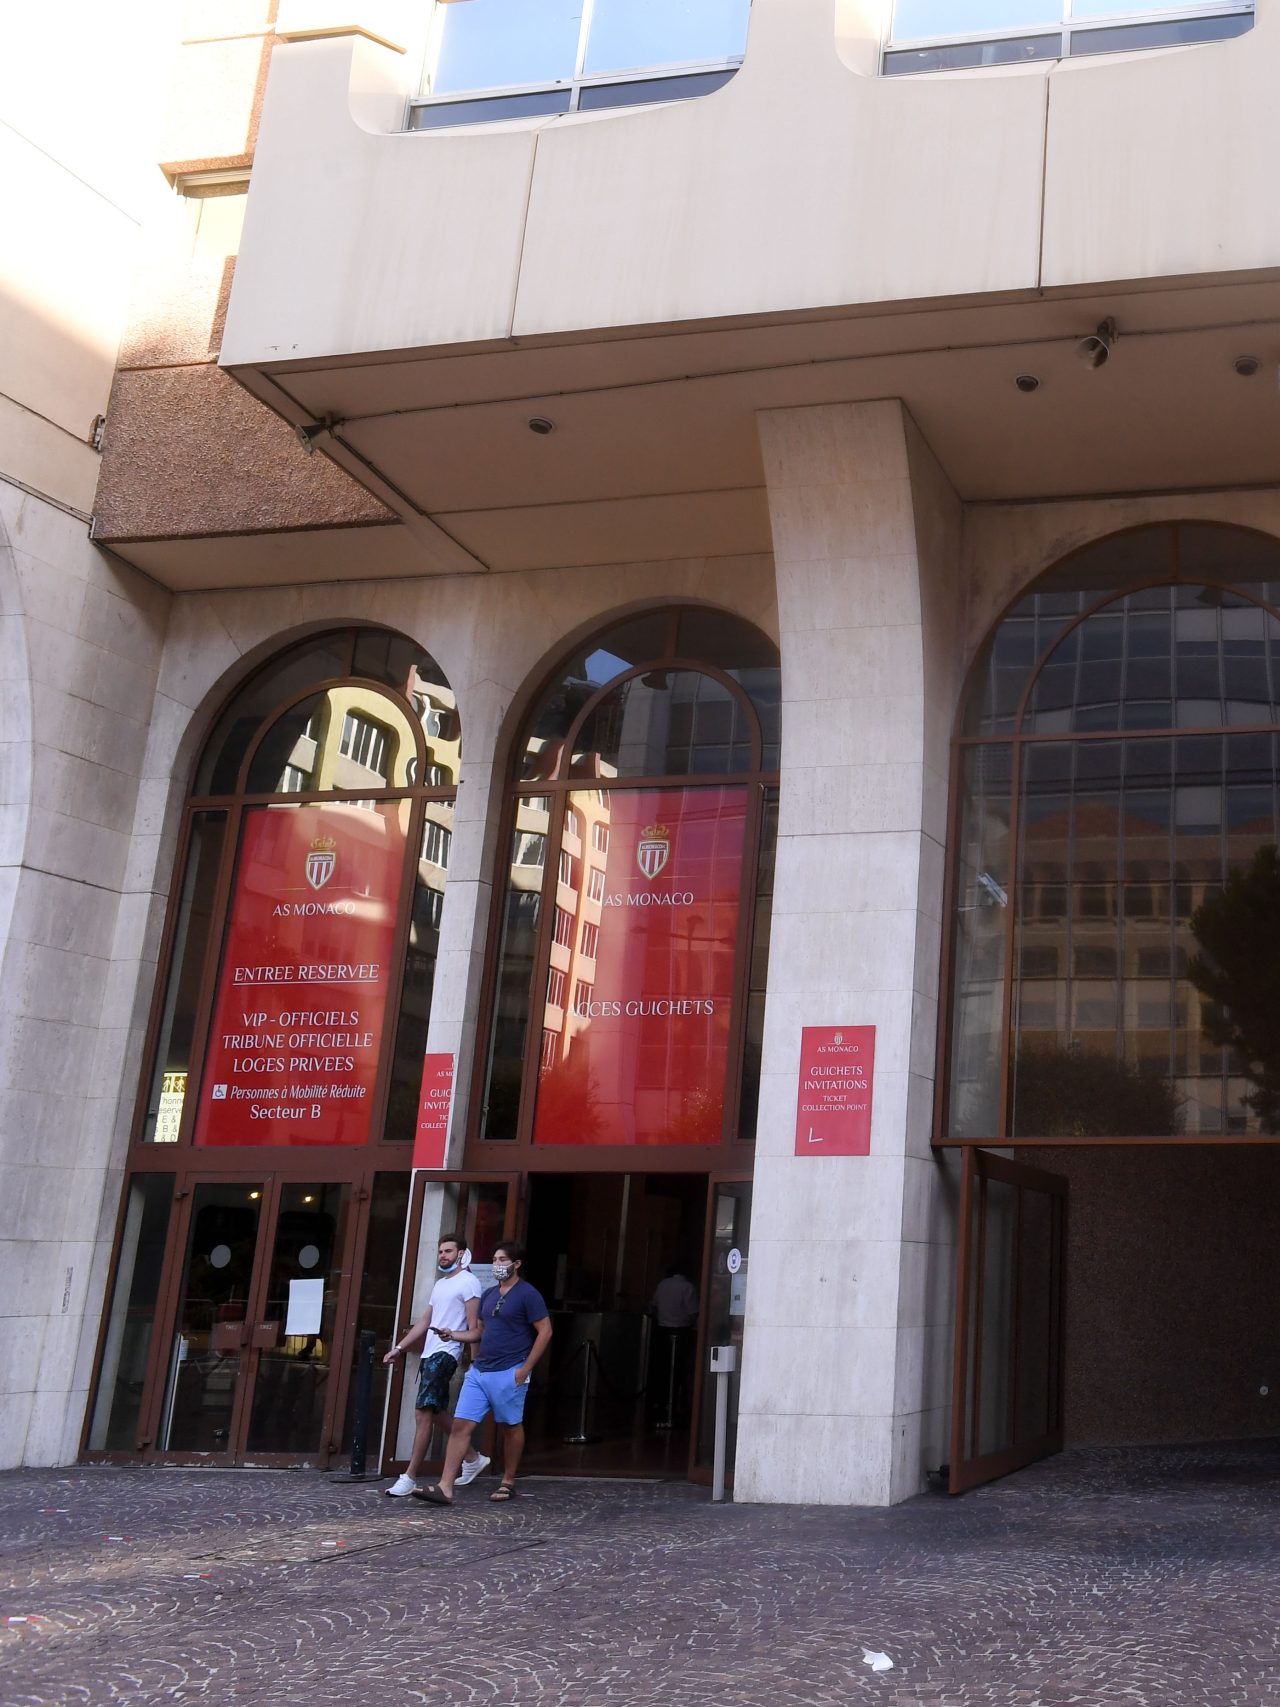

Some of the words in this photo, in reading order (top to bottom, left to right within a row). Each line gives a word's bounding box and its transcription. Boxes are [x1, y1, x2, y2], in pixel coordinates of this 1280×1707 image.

[604, 894, 622, 907] AS
[626, 892, 694, 906] MONACO
[273, 903, 291, 916] AS
[293, 902, 356, 916] MONACO
[234, 966, 294, 982] ENTREE
[298, 964, 379, 980] RESERVEE
[566, 1000, 621, 1017] ACCES
[625, 999, 714, 1016] GUICHETS
[242, 1012, 267, 1027] VIP
[279, 1011, 359, 1027] OFFICIELS
[223, 1034, 285, 1049] TRIBUNE
[288, 1033, 373, 1048] OFFICIELLE
[827, 1045, 859, 1053] MONACO
[233, 1057, 285, 1073] LOGES
[289, 1056, 354, 1072] PRIVEES
[810, 1066, 863, 1076] GUICHETS
[804, 1079, 868, 1090] INVITATIONS
[230, 1085, 279, 1100] Personnes
[280, 1085, 288, 1099] à
[289, 1084, 328, 1099] Mobilité
[329, 1084, 367, 1098] Réduite
[429, 1088, 453, 1098] GUIC
[822, 1094, 848, 1102] TICKET
[250, 1104, 307, 1120] Secteur
[311, 1104, 321, 1119] B
[424, 1101, 451, 1110] INVITA
[801, 1104, 845, 1112] COLLECTION
[846, 1103, 868, 1111] POINT
